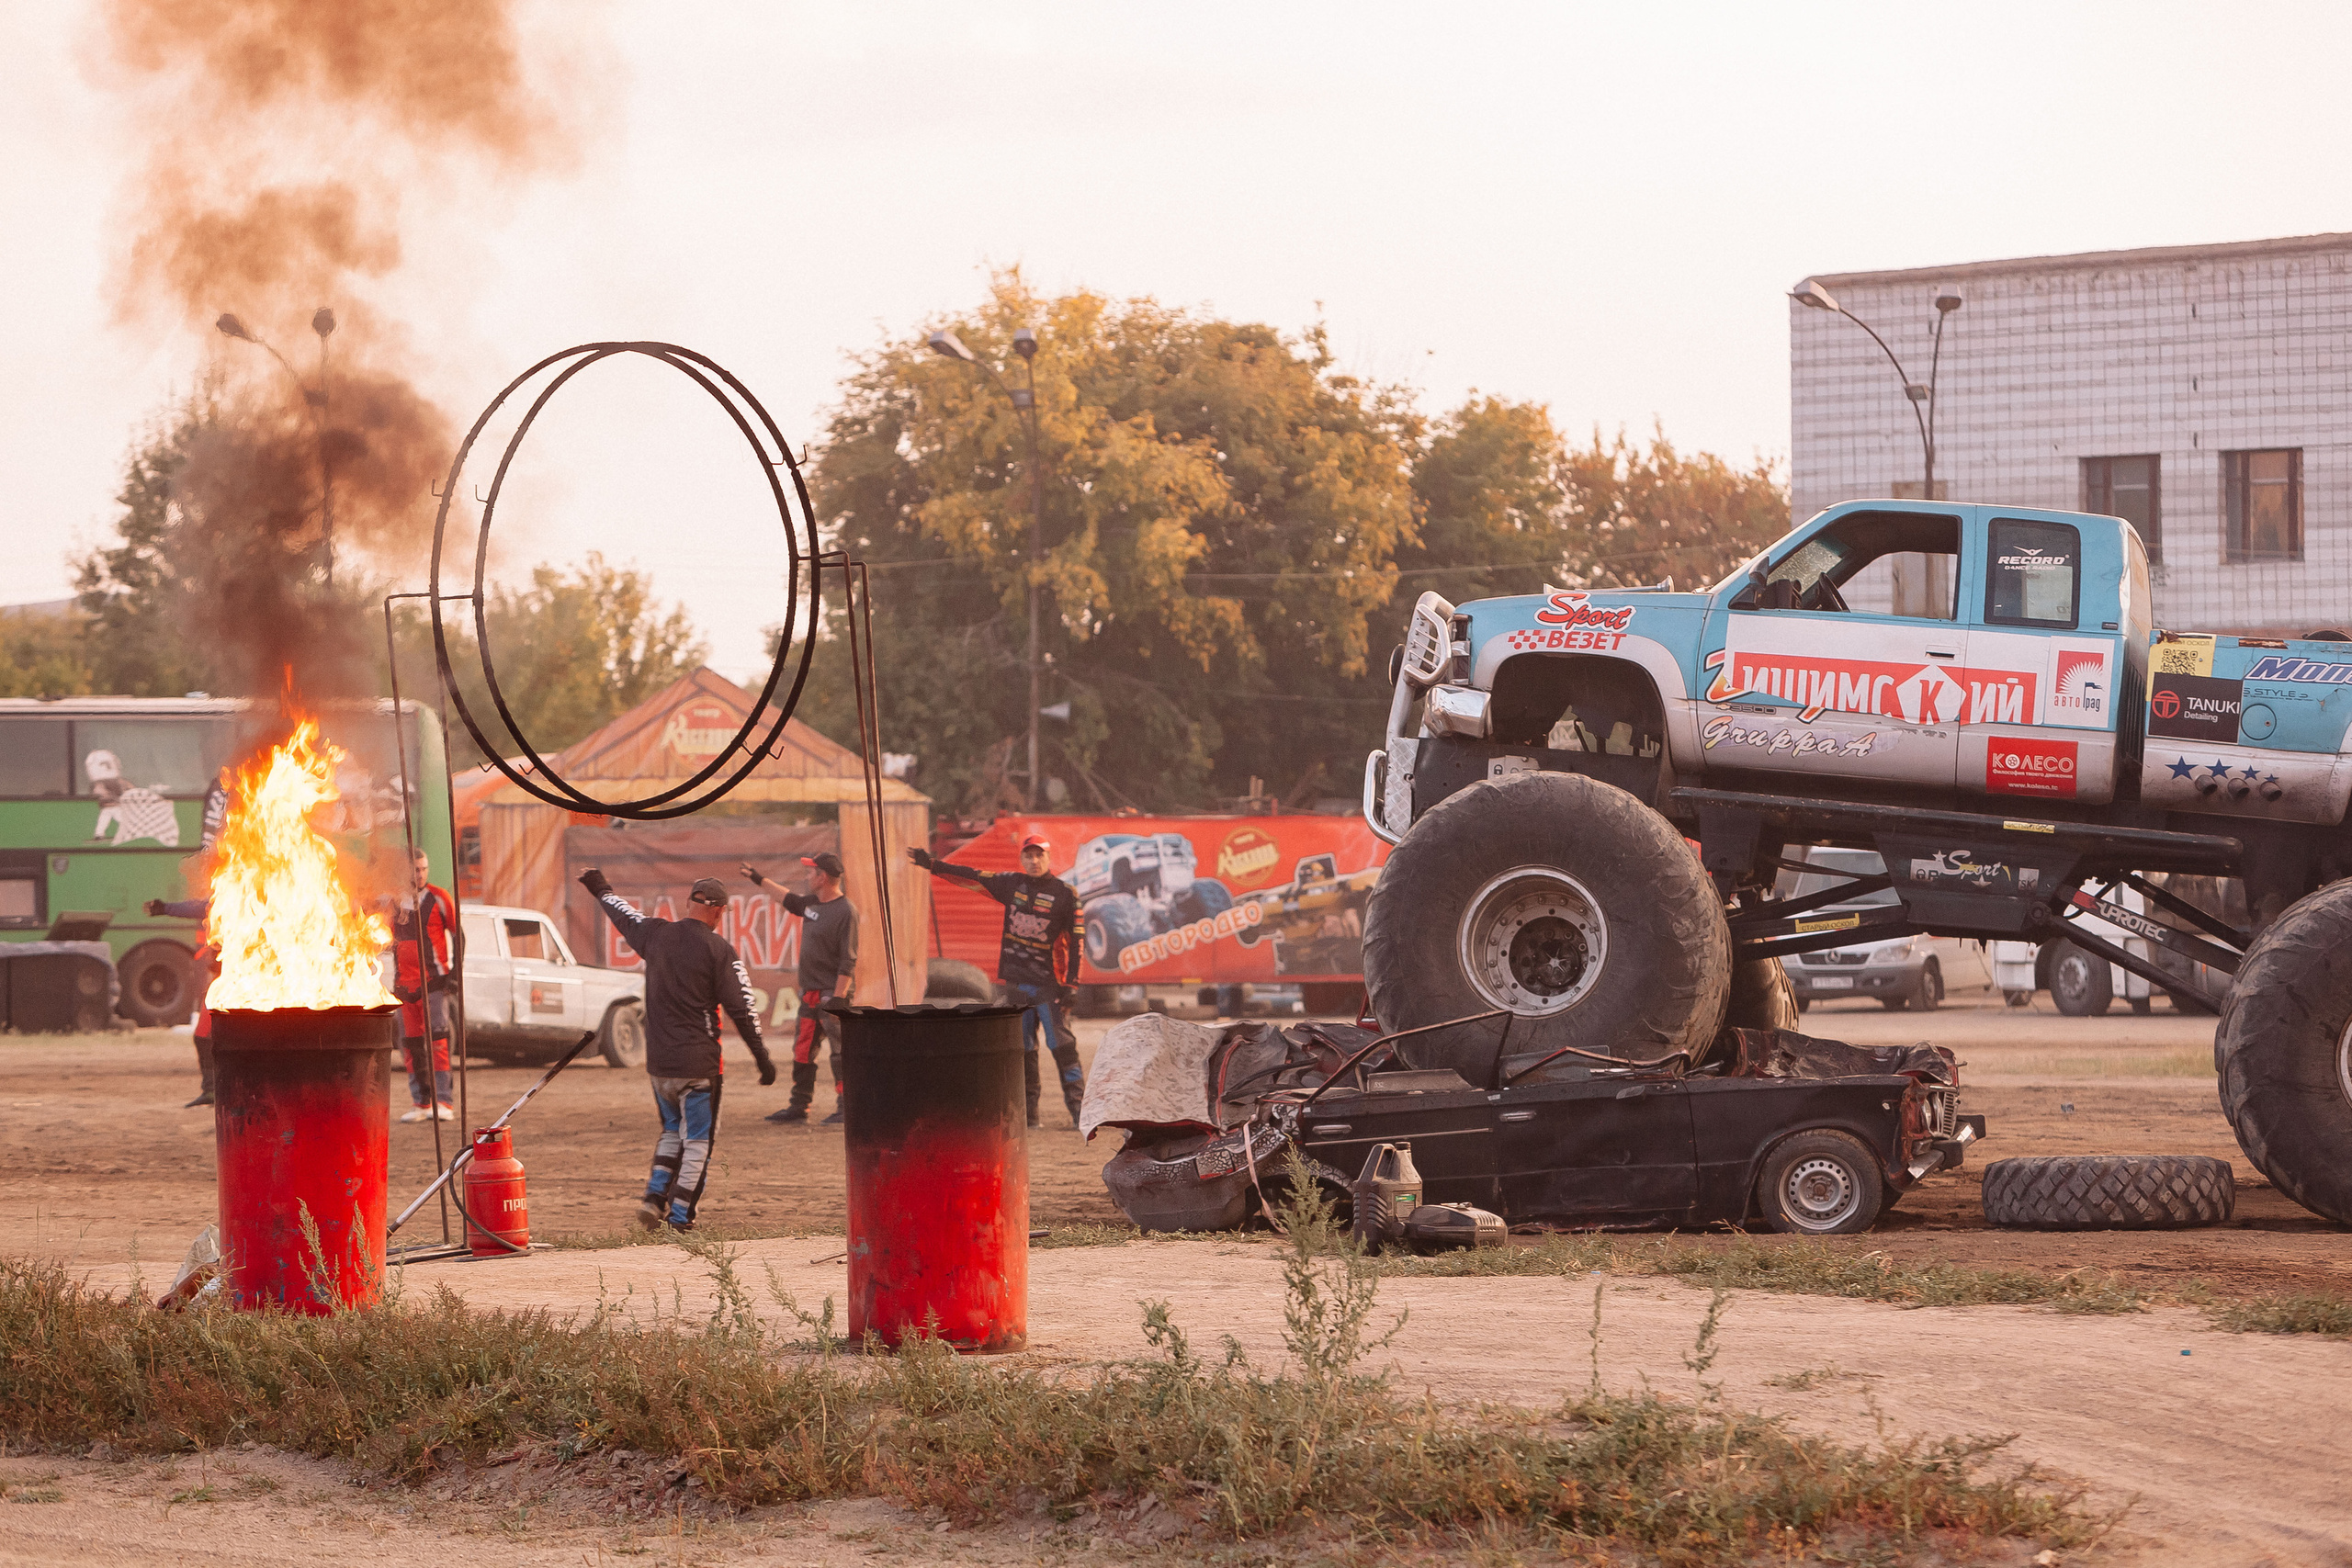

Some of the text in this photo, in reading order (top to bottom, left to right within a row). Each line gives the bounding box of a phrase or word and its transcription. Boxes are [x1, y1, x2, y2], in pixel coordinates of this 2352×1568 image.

[1997, 556, 2065, 565] RECORD
[1537, 592, 1633, 630] Sport
[1546, 630, 1627, 650] ВЕЗЕТ
[2243, 655, 2352, 685] Mon
[2254, 688, 2296, 698] STYLE
[1730, 703, 1777, 715] 3500
[2187, 696, 2240, 714] TANUKI
[2184, 711, 2218, 723] Detailing
[1992, 752, 2075, 773] КОЛЕСО
[1120, 901, 1262, 973] АВТОРОДЕО
